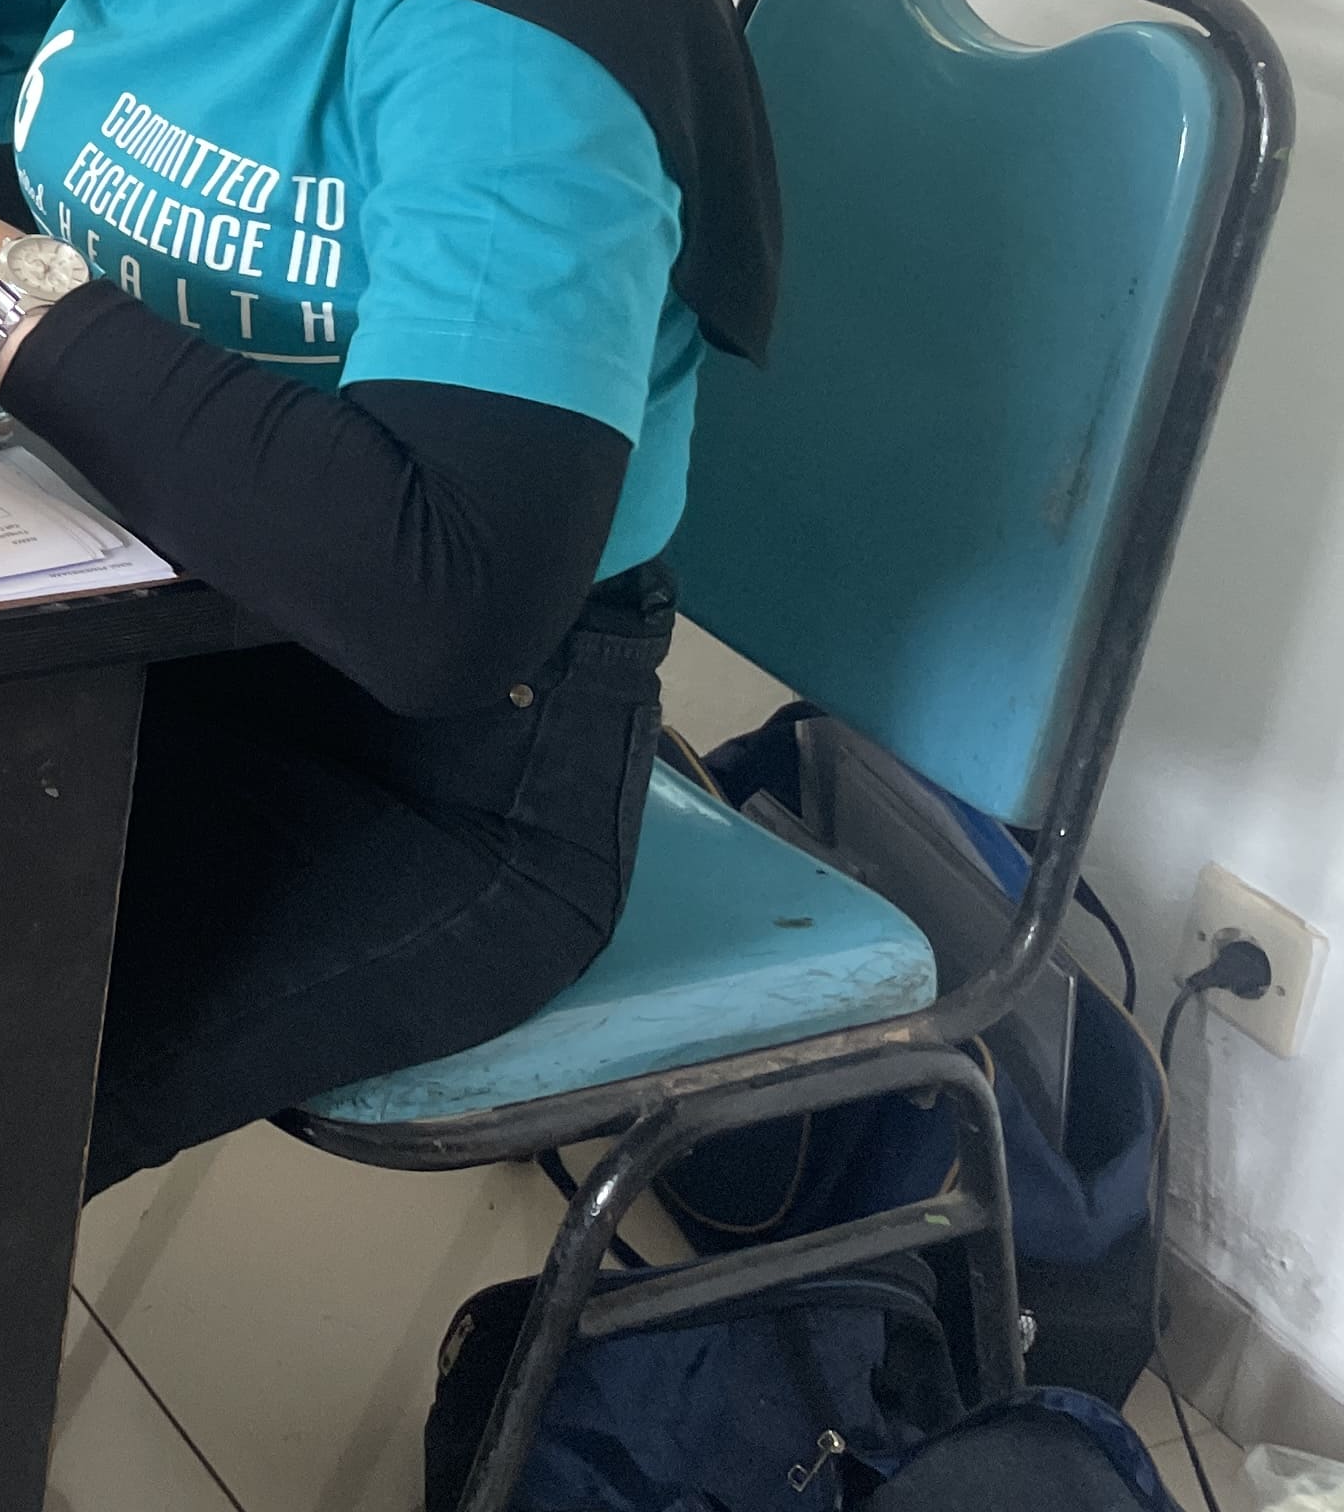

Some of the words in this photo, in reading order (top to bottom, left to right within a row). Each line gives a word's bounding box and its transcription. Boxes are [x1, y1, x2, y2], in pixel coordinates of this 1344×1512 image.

[63, 141, 271, 277] EXCELLENCE
[286, 229, 342, 289] IN
[100, 91, 280, 214] COMMITTED
[291, 174, 345, 231] TO
